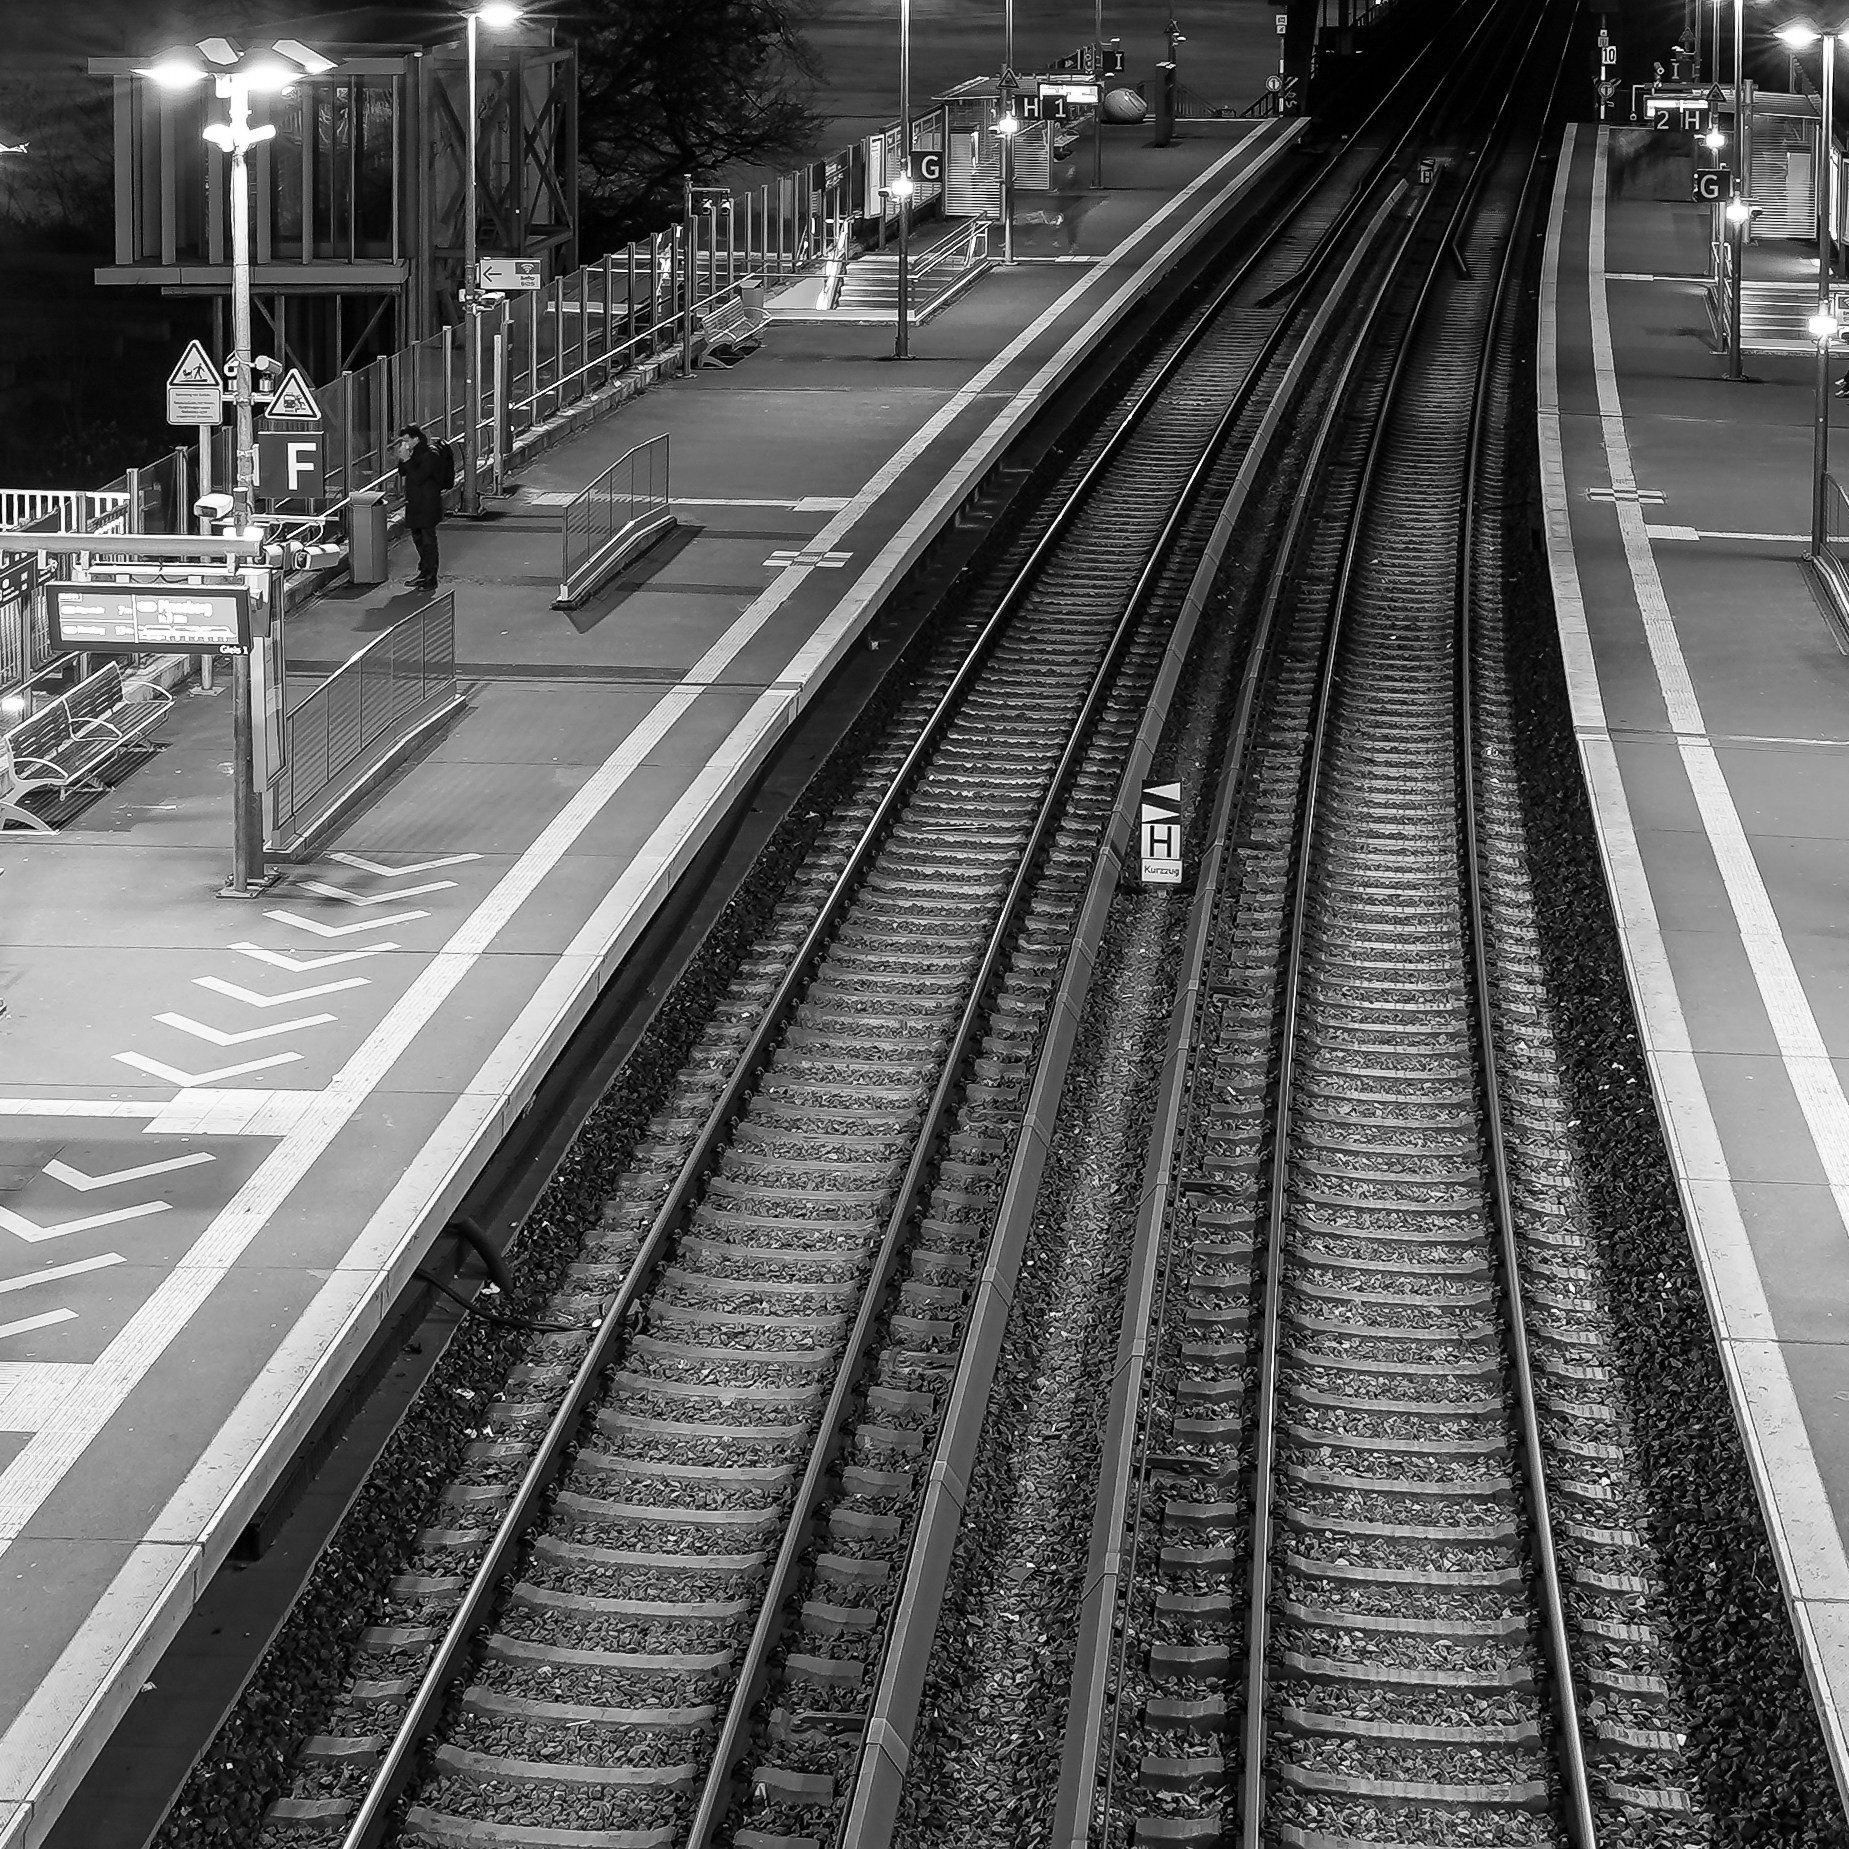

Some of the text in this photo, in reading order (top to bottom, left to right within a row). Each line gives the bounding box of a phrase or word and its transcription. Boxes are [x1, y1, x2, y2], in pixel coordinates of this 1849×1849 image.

[1603, 47, 1615, 63] 10
[1023, 97, 1039, 118] H
[1054, 98, 1066, 118] 1
[1656, 110, 1669, 130] 2
[1684, 110, 1700, 130] H
[921, 155, 940, 180] G
[1700, 174, 1719, 199] G
[286, 442, 317, 491] F
[1149, 824, 1172, 858] H
[1144, 864, 1180, 877] Kurzzug
